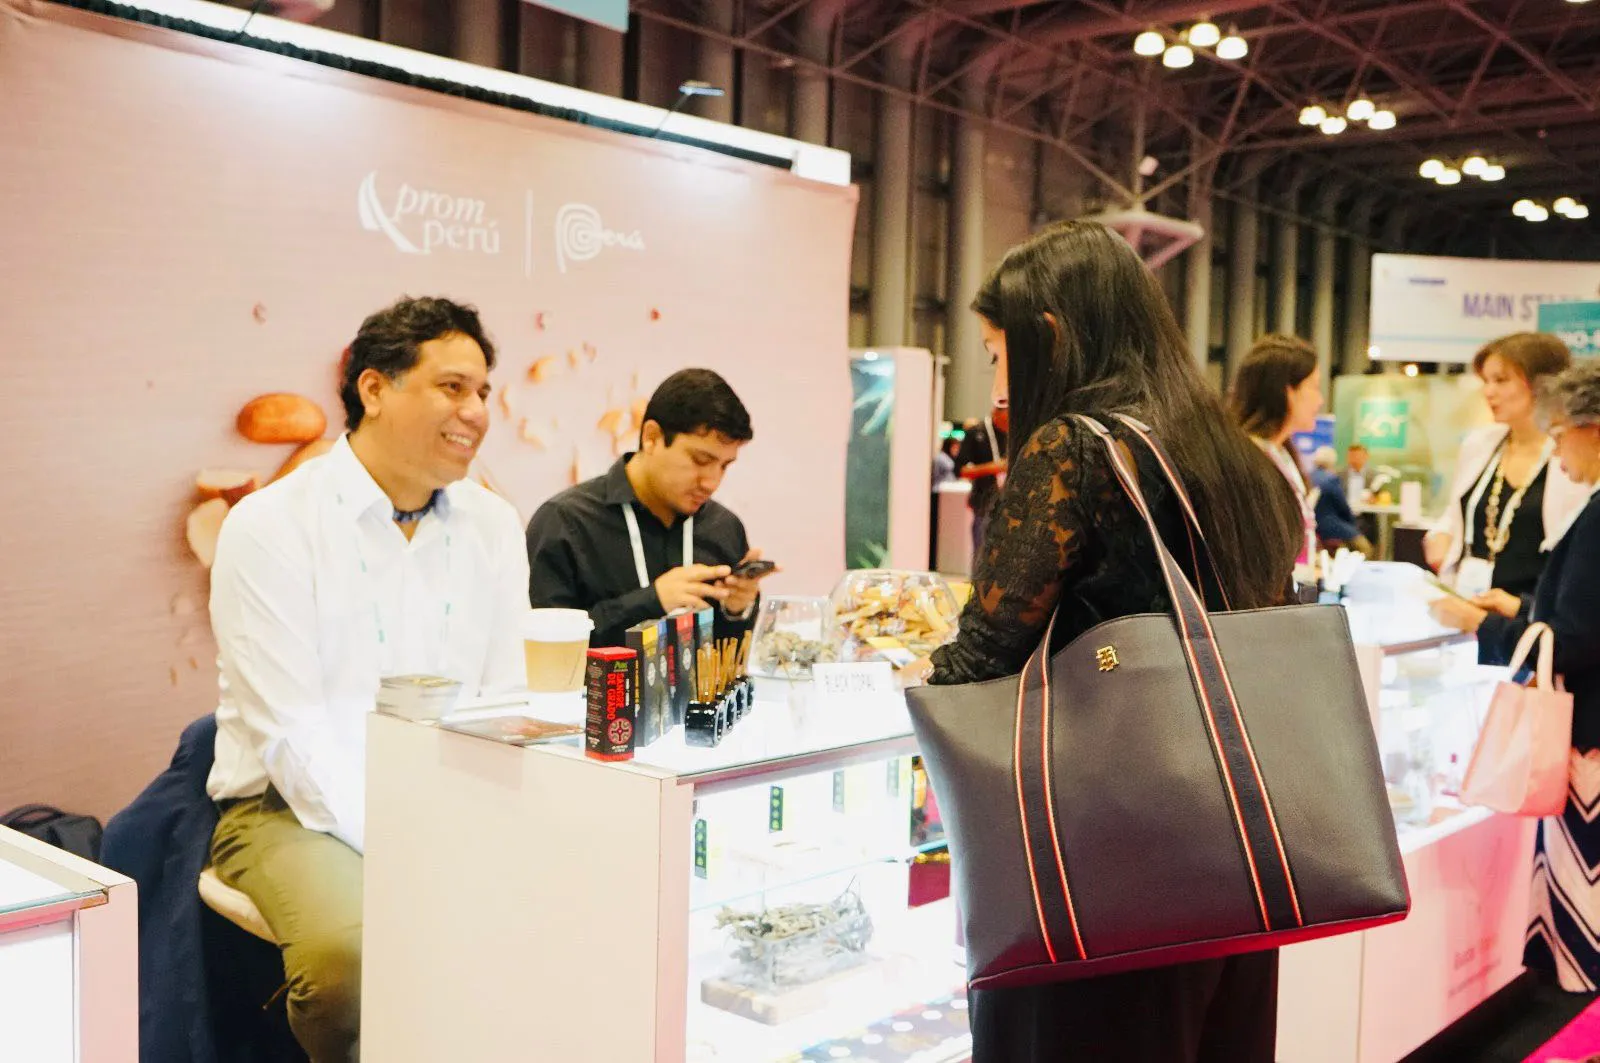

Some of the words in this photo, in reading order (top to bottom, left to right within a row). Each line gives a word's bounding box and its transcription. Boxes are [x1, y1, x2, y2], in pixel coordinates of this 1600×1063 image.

[391, 183, 486, 225] prom
[420, 219, 500, 255] perú
[1462, 293, 1514, 320] MAIN
